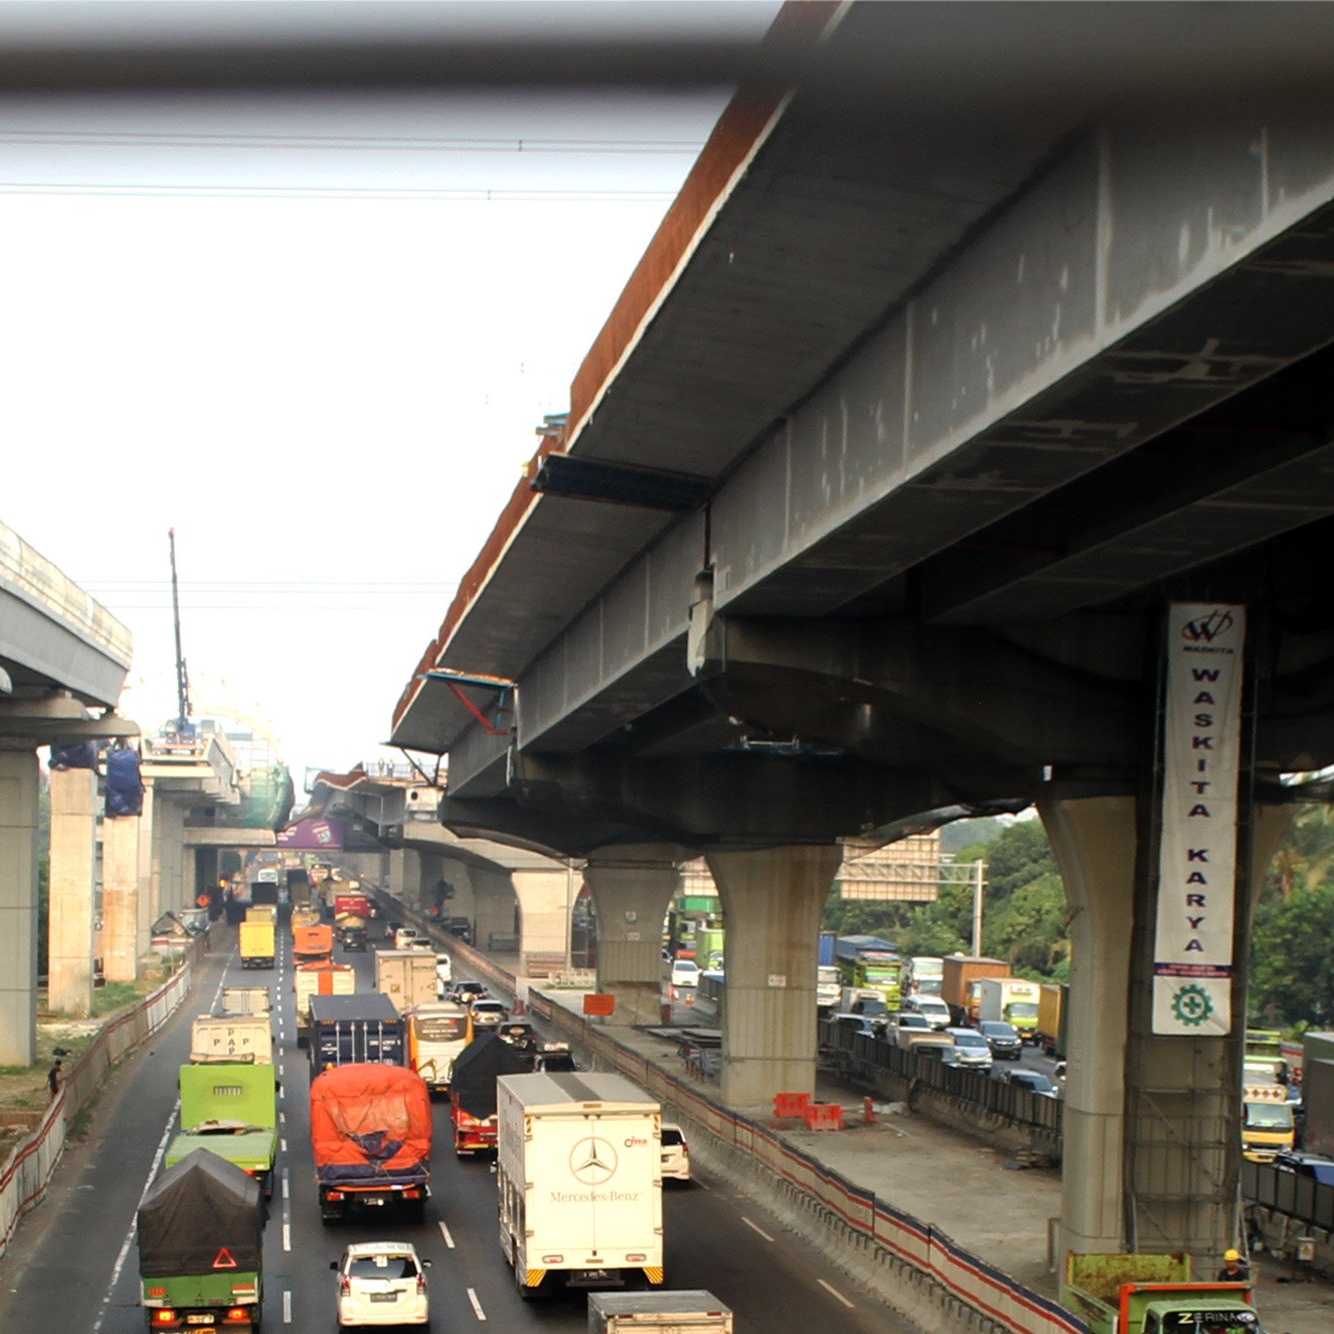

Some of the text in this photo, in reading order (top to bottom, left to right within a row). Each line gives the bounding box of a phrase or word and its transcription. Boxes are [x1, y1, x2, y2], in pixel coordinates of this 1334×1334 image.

[1188, 668, 1220, 817] WASKITA
[1185, 848, 1210, 952] KARYA
[550, 1191, 639, 1202] Mercedes-Benz
